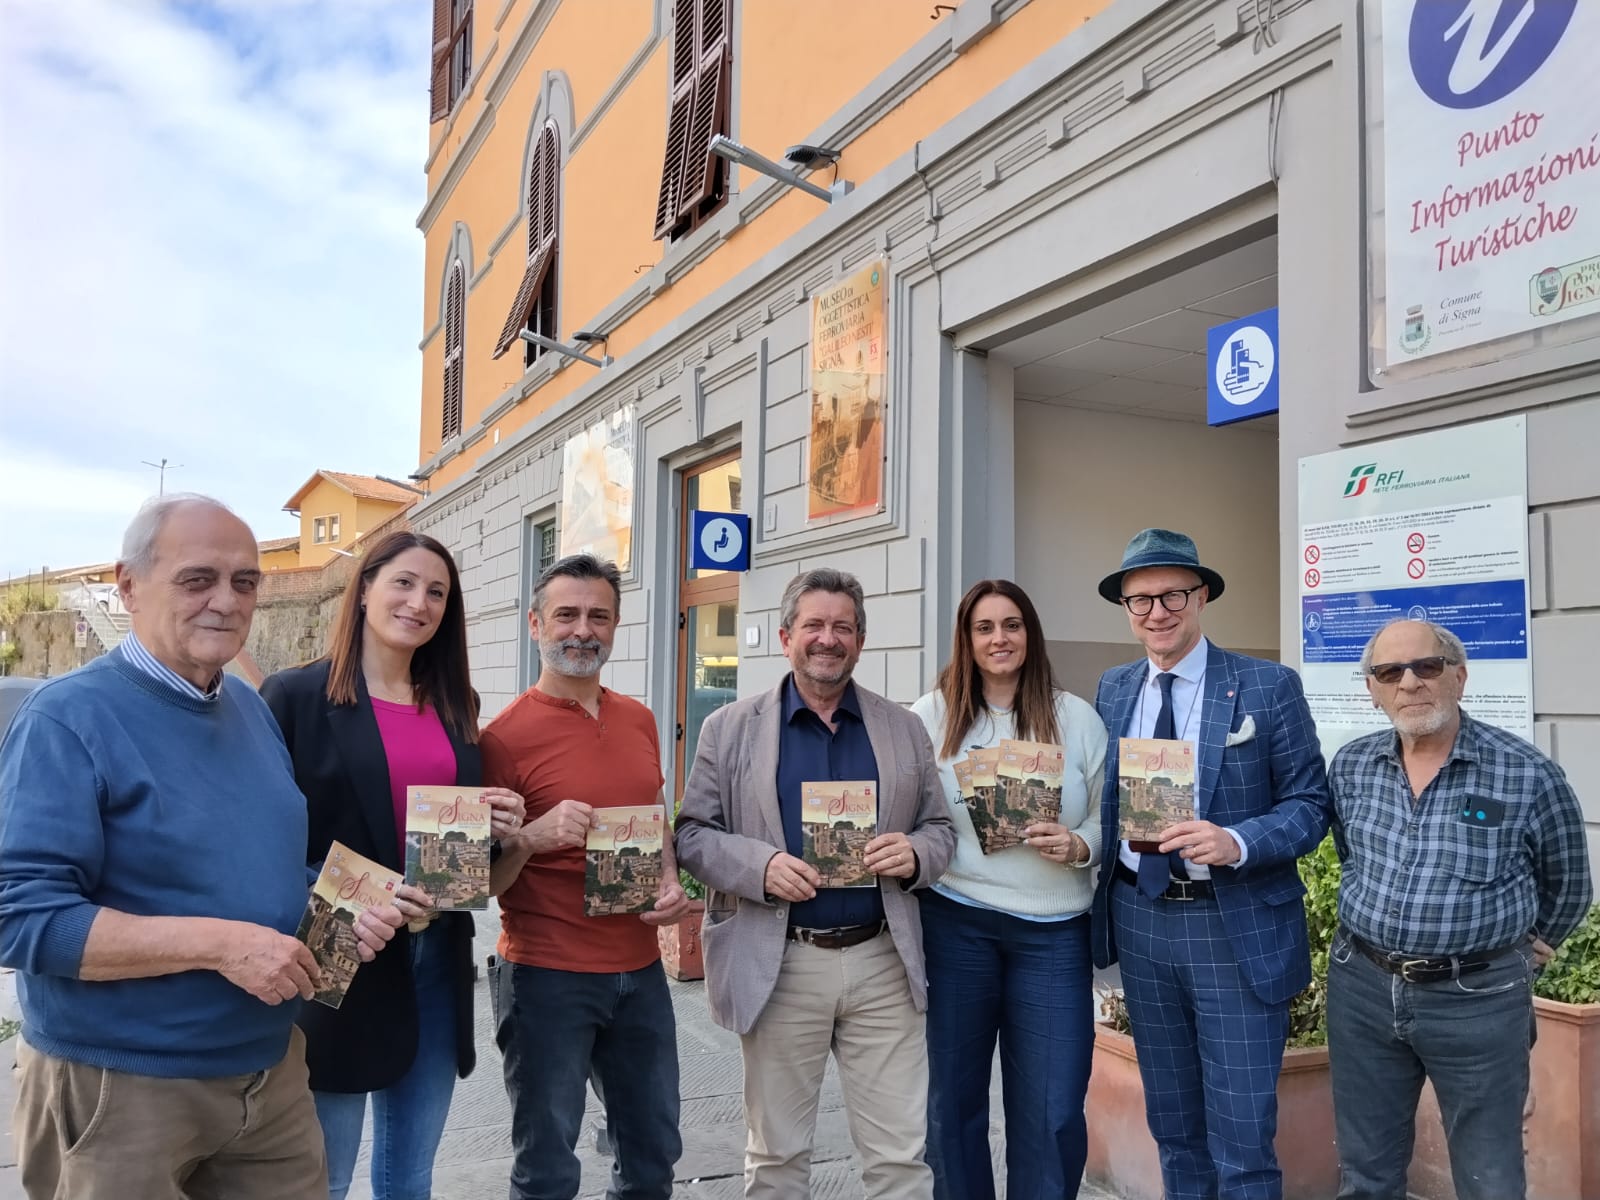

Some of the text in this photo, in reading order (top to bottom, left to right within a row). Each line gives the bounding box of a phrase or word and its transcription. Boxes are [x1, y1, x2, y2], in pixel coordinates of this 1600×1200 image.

[1457, 110, 1545, 168] Punto
[1410, 132, 1600, 234] Informazioni
[1435, 200, 1579, 272] Turistiche
[819, 287, 847, 312] MUSEO
[1440, 290, 1483, 310] Comune
[818, 311, 865, 342] FERROVIARIA
[1438, 306, 1481, 326] di Signa
[1373, 473, 1471, 494] RETE FERROVIARIA ITALIANA
[1375, 470, 1404, 487] RFI
[437, 795, 486, 833] SIGNA
[828, 790, 871, 823] SIGNA
[613, 815, 658, 849] SIGNA
